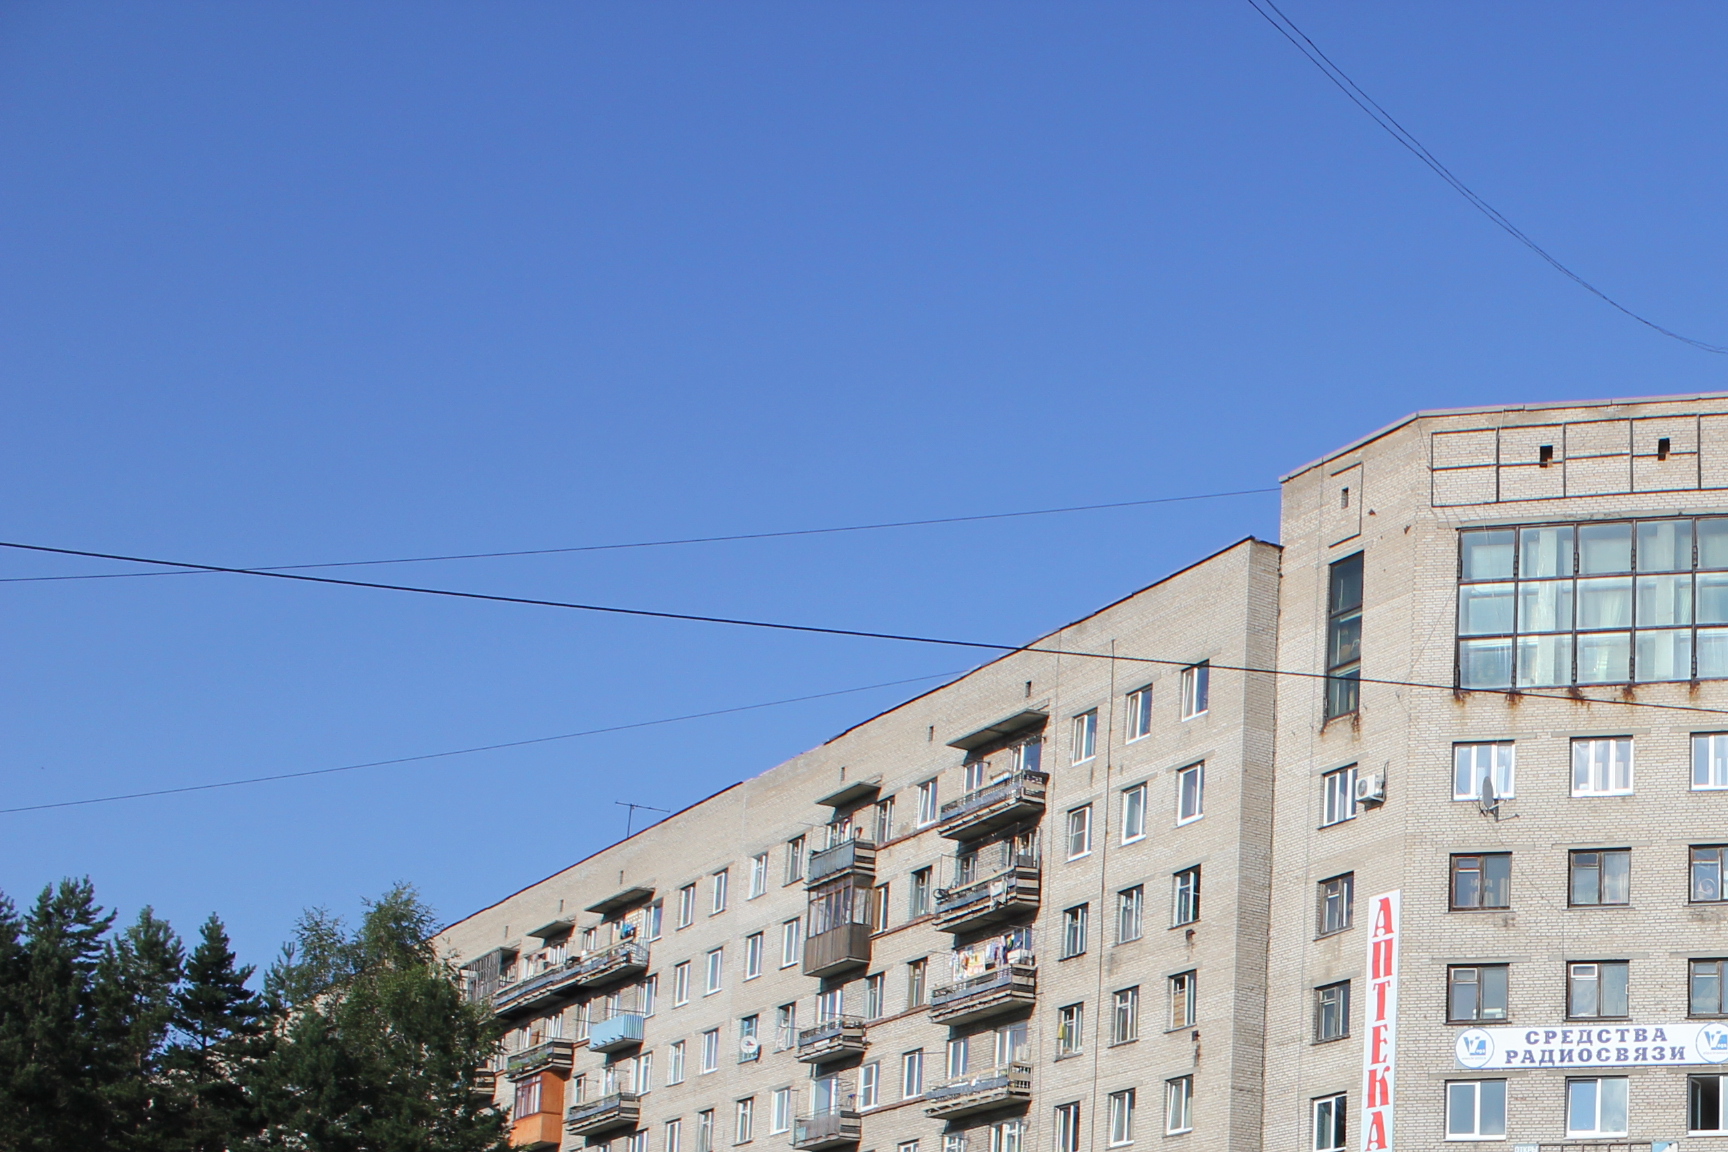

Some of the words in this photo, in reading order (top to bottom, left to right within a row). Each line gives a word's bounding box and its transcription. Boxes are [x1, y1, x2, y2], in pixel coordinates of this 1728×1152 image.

[1365, 897, 1394, 1151] АПТЕКА
[1525, 1028, 1667, 1046] СРЕДСТВА
[1505, 1046, 1686, 1066] РАДИОСВЯЗИ
